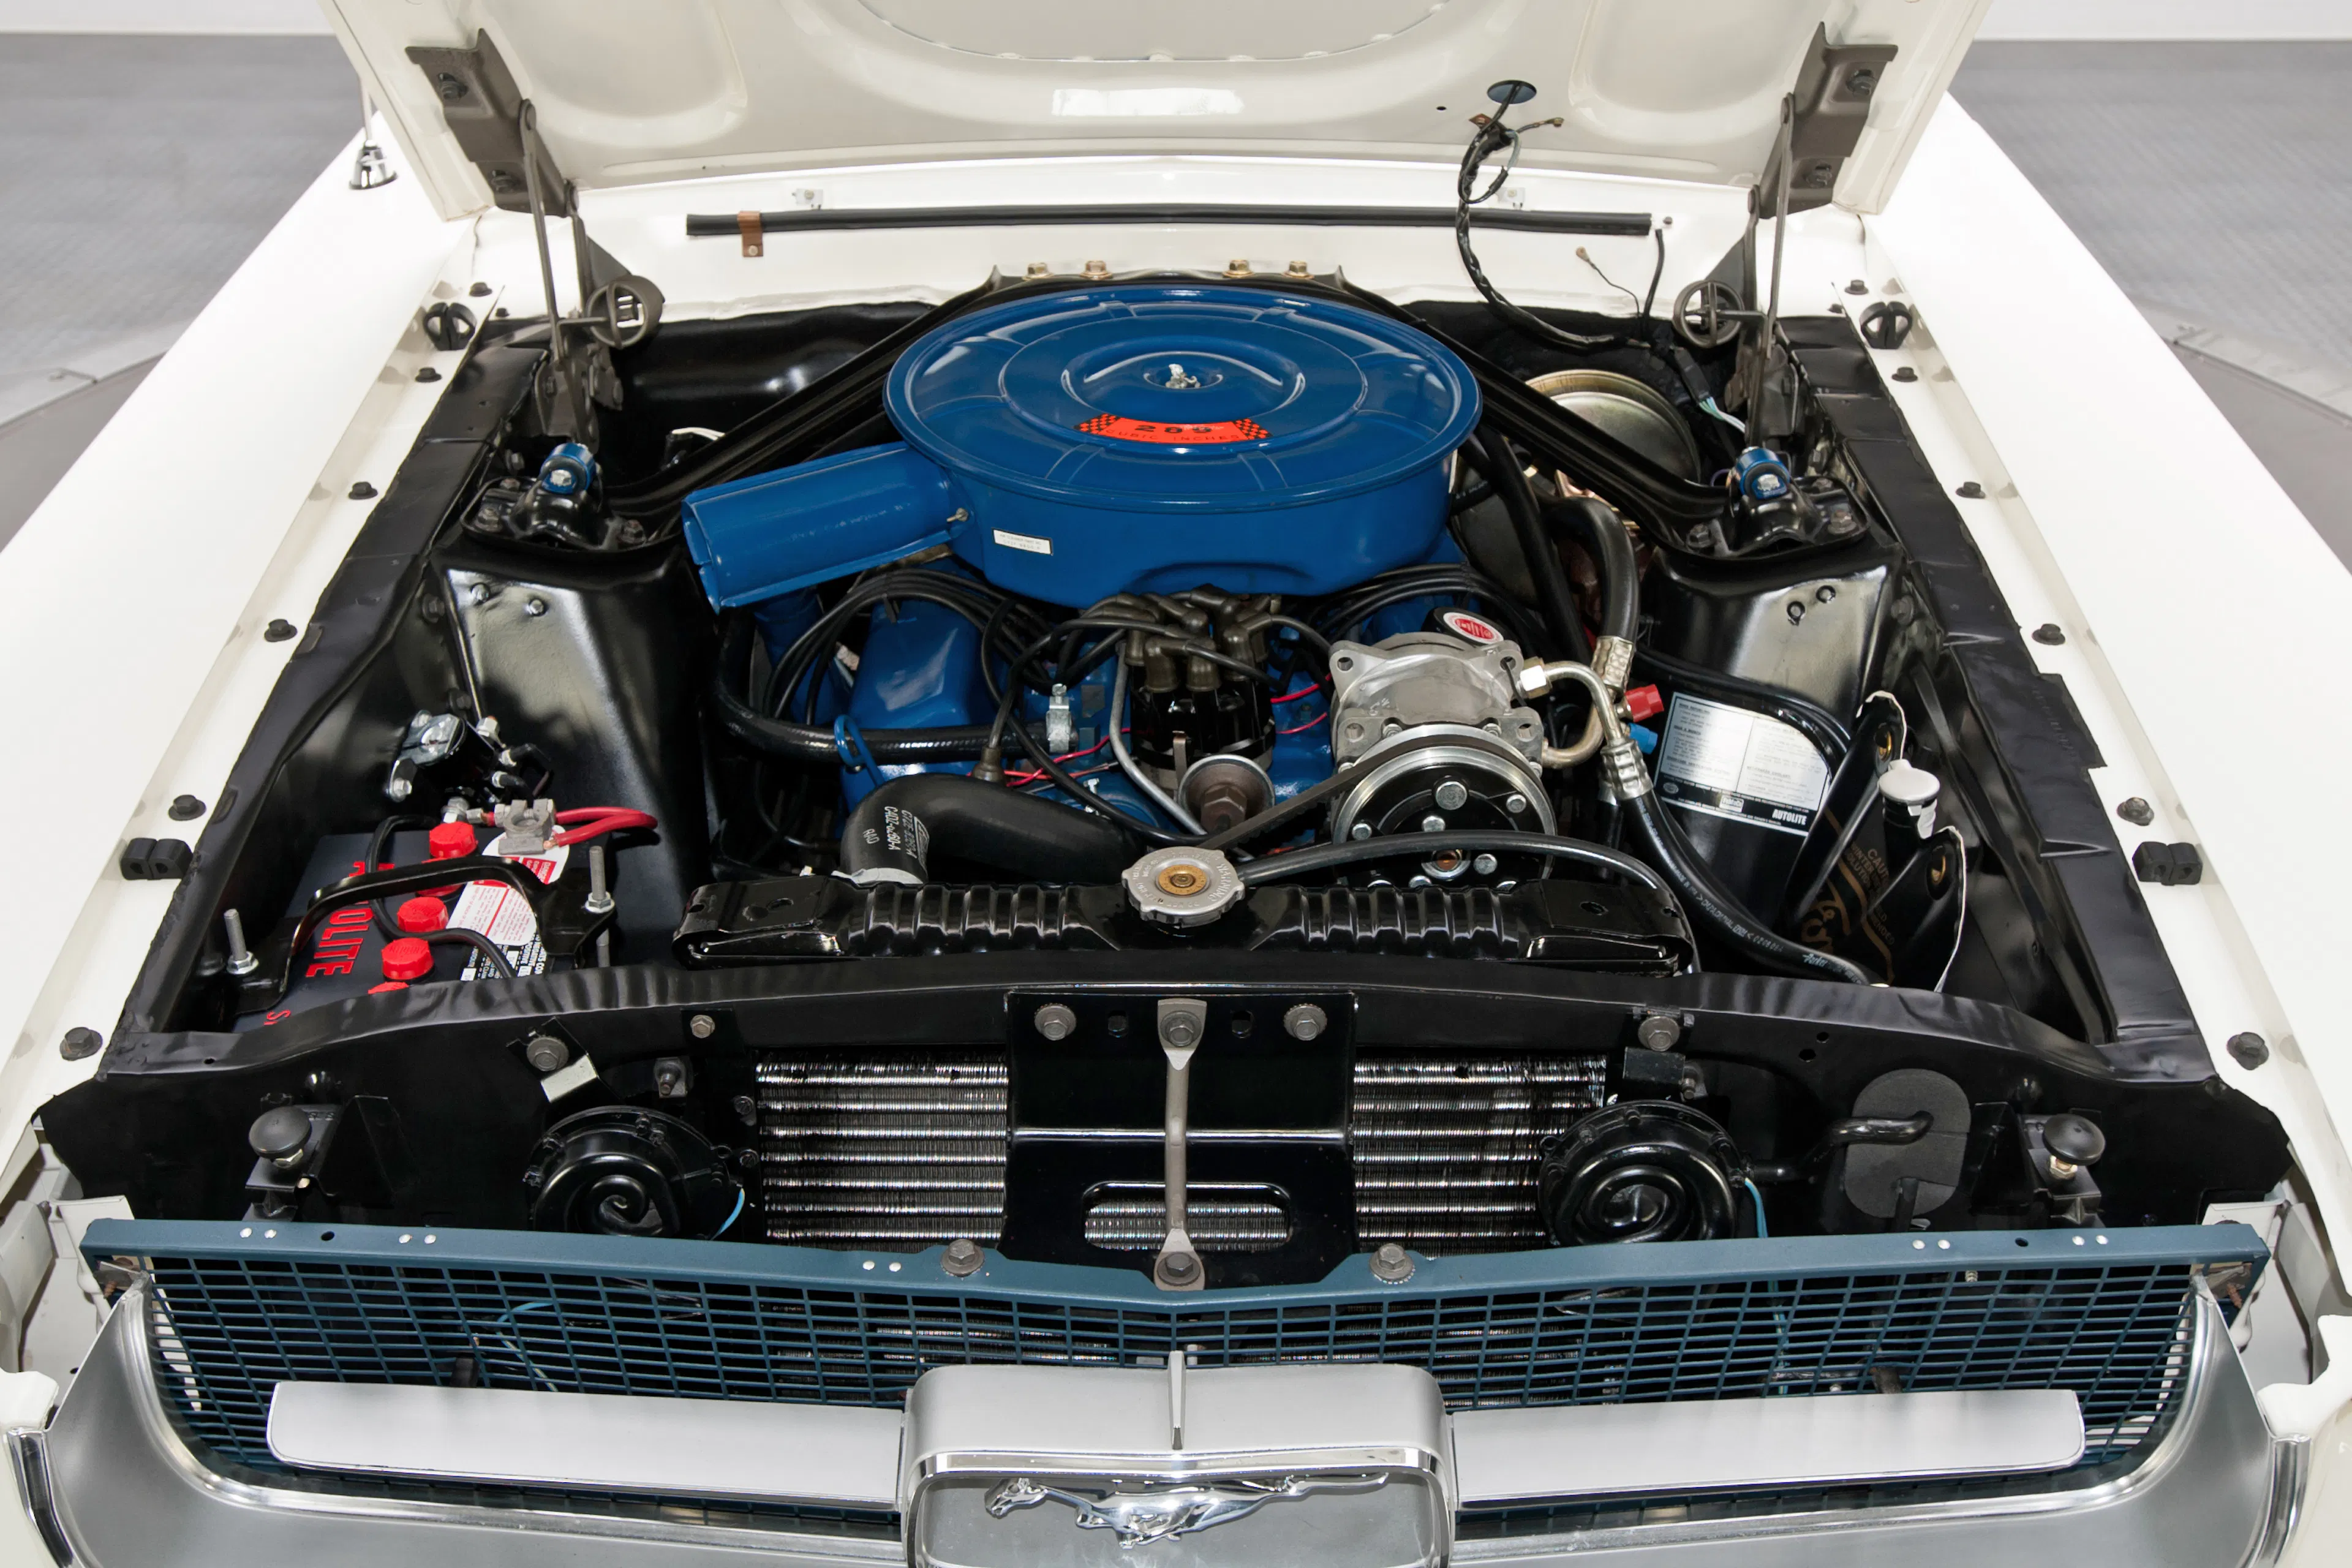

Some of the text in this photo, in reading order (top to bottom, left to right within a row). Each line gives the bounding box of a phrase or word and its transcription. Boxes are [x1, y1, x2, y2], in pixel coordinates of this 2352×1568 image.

[1105, 429, 1159, 440] CUBIC
[1772, 809, 1807, 826] AUTOLITE
[862, 828, 880, 844] RAD
[305, 861, 395, 978] AOLITE
